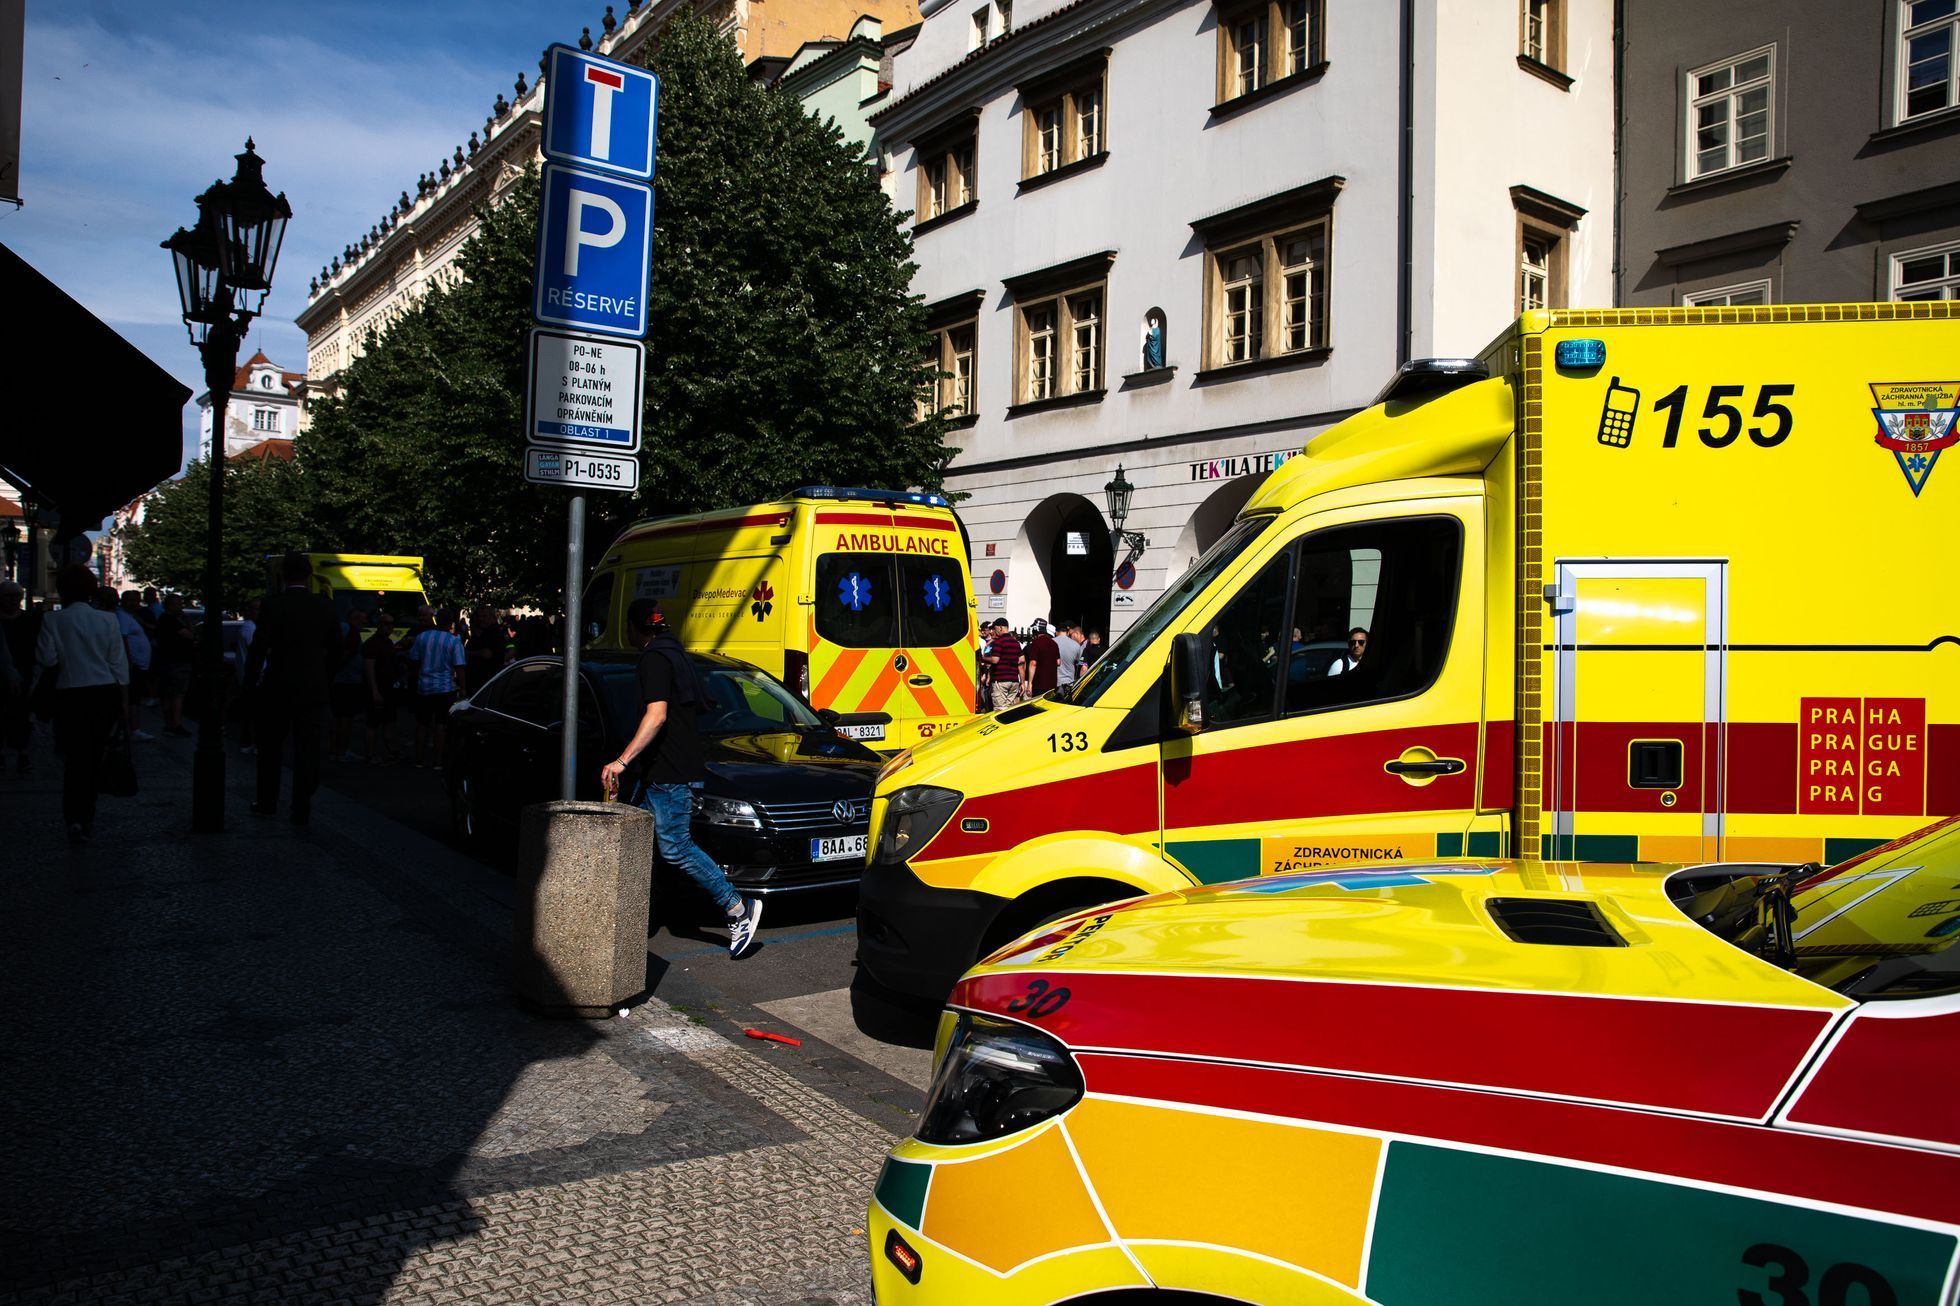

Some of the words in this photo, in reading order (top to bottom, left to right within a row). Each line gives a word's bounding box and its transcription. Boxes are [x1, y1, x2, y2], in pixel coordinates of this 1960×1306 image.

[564, 188, 626, 277] P
[548, 286, 636, 317] RÉSERVÉ
[573, 345, 603, 359] PO-NE
[568, 360, 596, 374] 08-06
[600, 364, 606, 375] h
[562, 376, 568, 386] S
[572, 377, 611, 392] PLATNÝM
[559, 392, 612, 408] PARKOVACÍM
[557, 408, 613, 424] OPRÁVNĚNÍM
[1654, 384, 1795, 448] 155
[560, 425, 600, 438] OBLAST
[605, 430, 609, 438] 1
[1905, 443, 1929, 451] 1857
[565, 460, 620, 480] P1-0535
[836, 533, 950, 556] AMBULANCE
[860, 726, 880, 736] 8321
[1046, 732, 1088, 752] 133
[822, 839, 845, 855] 8AA
[1294, 846, 1403, 859] ZDRAVOTNICKÁ
[1007, 979, 1071, 1019] 30
